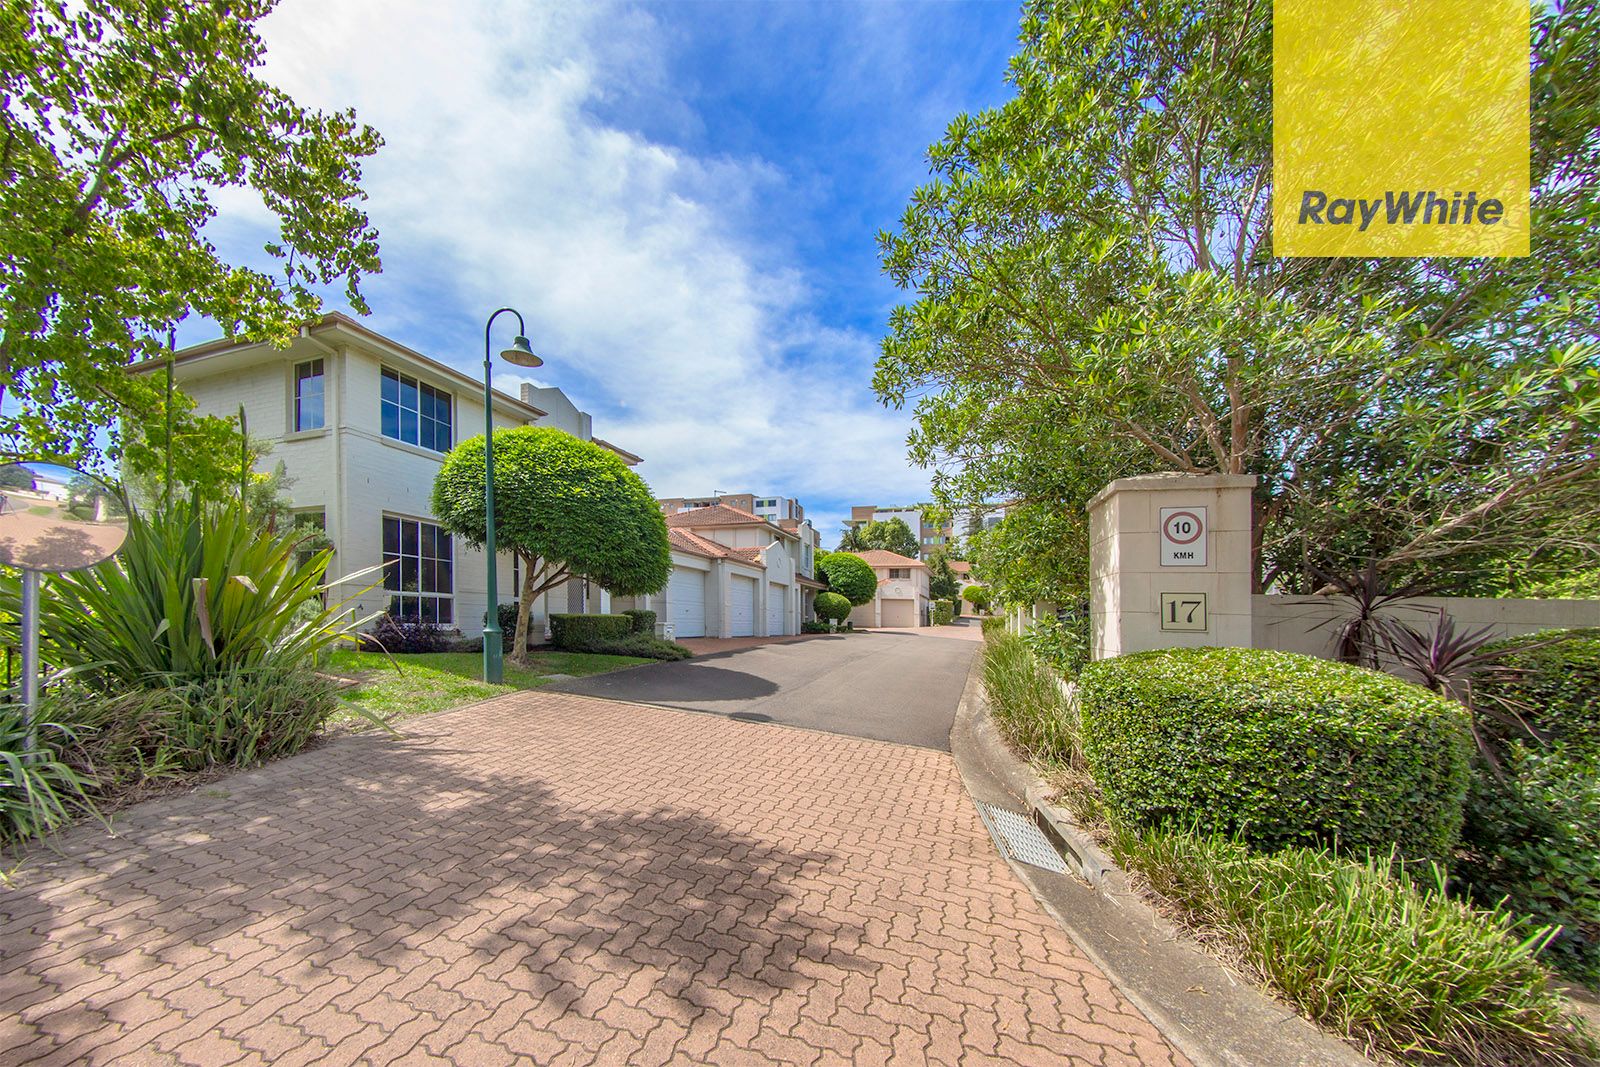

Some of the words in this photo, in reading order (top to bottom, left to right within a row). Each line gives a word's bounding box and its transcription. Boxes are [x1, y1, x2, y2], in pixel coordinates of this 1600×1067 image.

[1173, 521, 1191, 534] 10
[1173, 551, 1194, 560] KMH
[1166, 600, 1202, 623] 17
